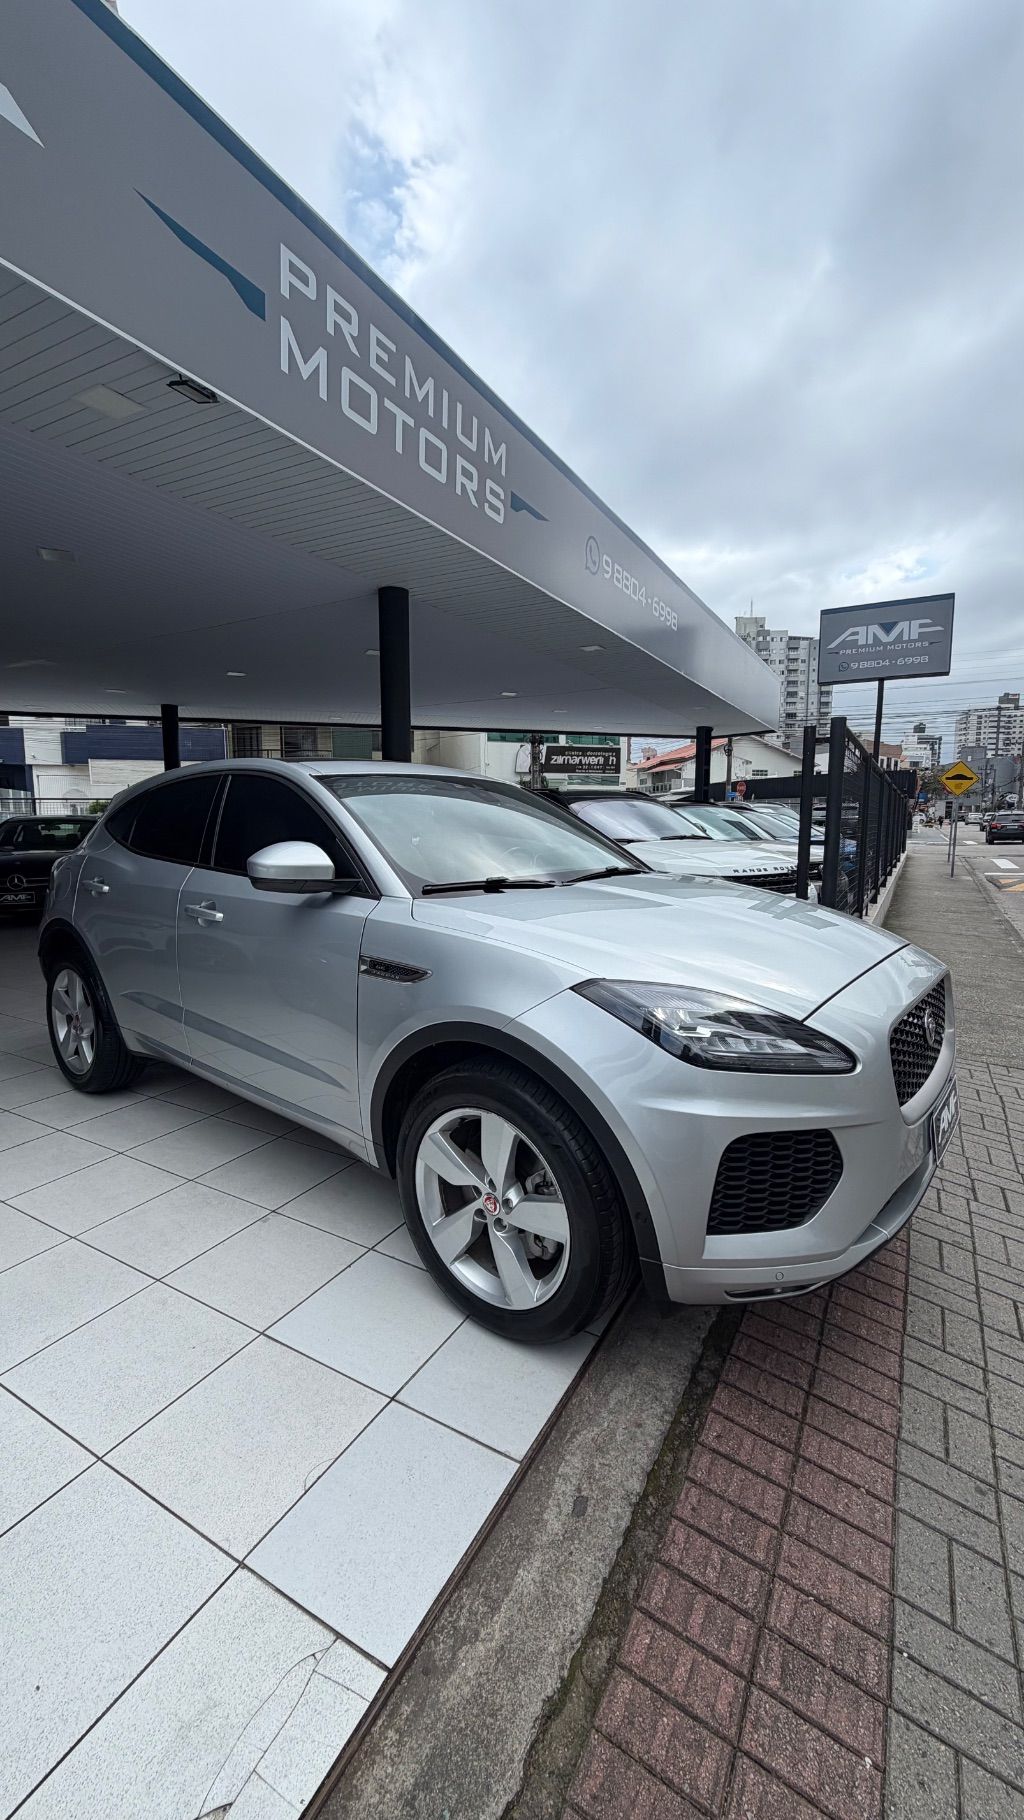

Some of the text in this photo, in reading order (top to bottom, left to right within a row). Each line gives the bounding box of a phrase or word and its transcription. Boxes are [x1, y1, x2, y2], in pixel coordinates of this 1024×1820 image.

[280, 242, 507, 477] PREMIUM
[280, 315, 506, 525] MOTORS
[826, 618, 945, 649] AMF
[840, 641, 929, 655] PREMIUM MOTORS
[938, 1090, 957, 1144] AMF
